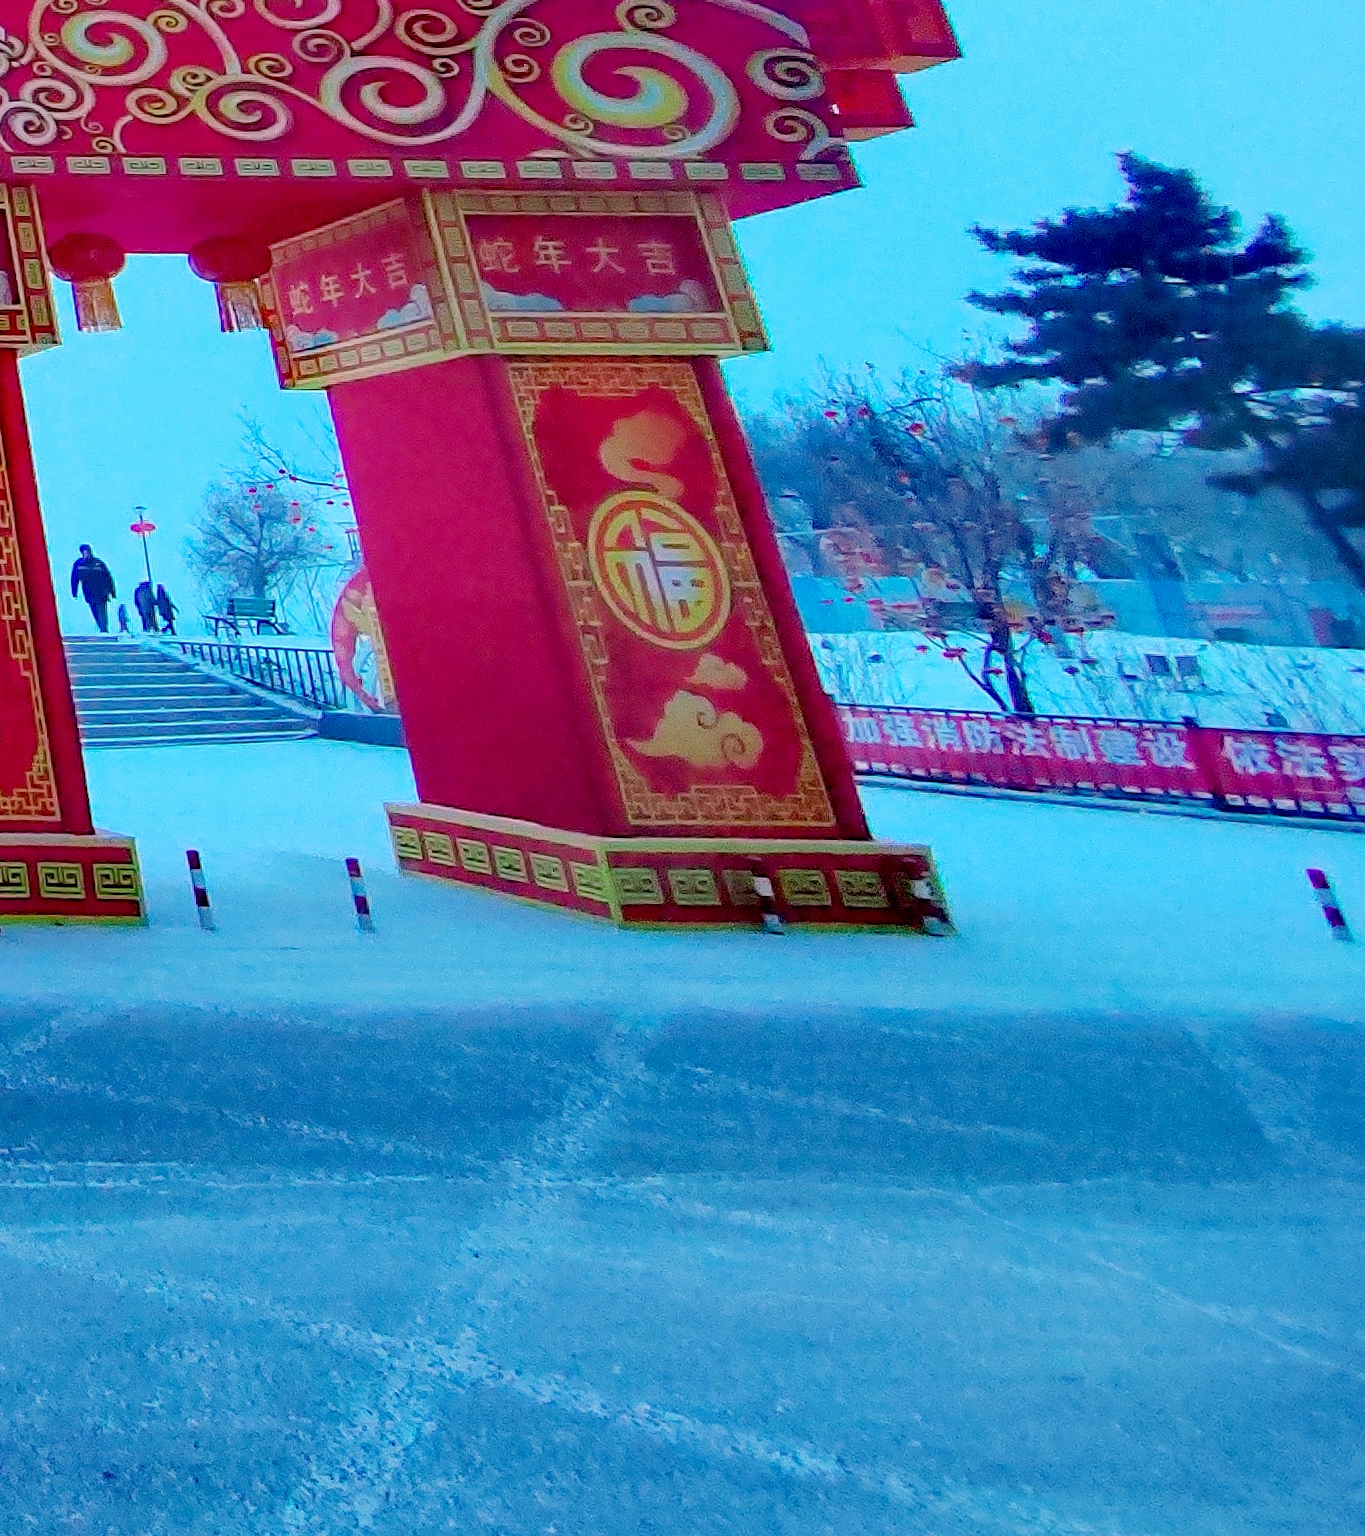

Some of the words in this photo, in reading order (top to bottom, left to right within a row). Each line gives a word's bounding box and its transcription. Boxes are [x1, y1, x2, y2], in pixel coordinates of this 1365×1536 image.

[477, 236, 677, 276] 蛇年大吉
[287, 252, 414, 318] 蛇年大吉
